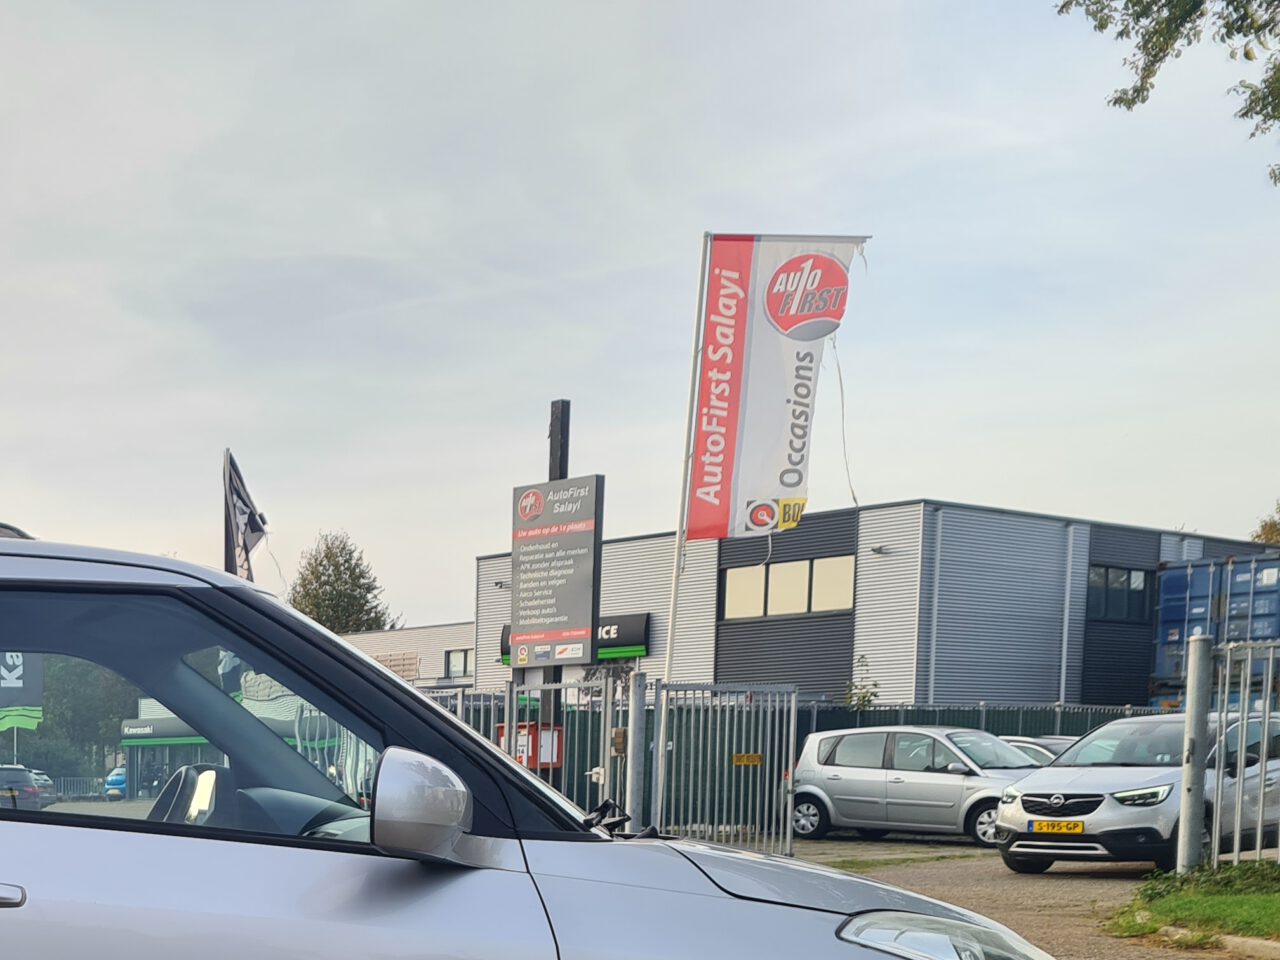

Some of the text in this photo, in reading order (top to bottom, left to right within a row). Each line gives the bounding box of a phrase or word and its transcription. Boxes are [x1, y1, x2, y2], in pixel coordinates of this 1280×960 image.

[696, 267, 745, 504] AutoFirst Salayi
[779, 350, 814, 488] Occasions
[547, 486, 589, 501] AutoFirst
[553, 500, 581, 513] Salayi
[527, 528, 541, 536] auto
[542, 527, 550, 535] op
[551, 525, 558, 533] de
[566, 522, 586, 533] plaats
[0, 652, 23, 687] Ka
[123, 725, 153, 735] Kawasaki
[1036, 822, 1079, 831] S-195-GP
